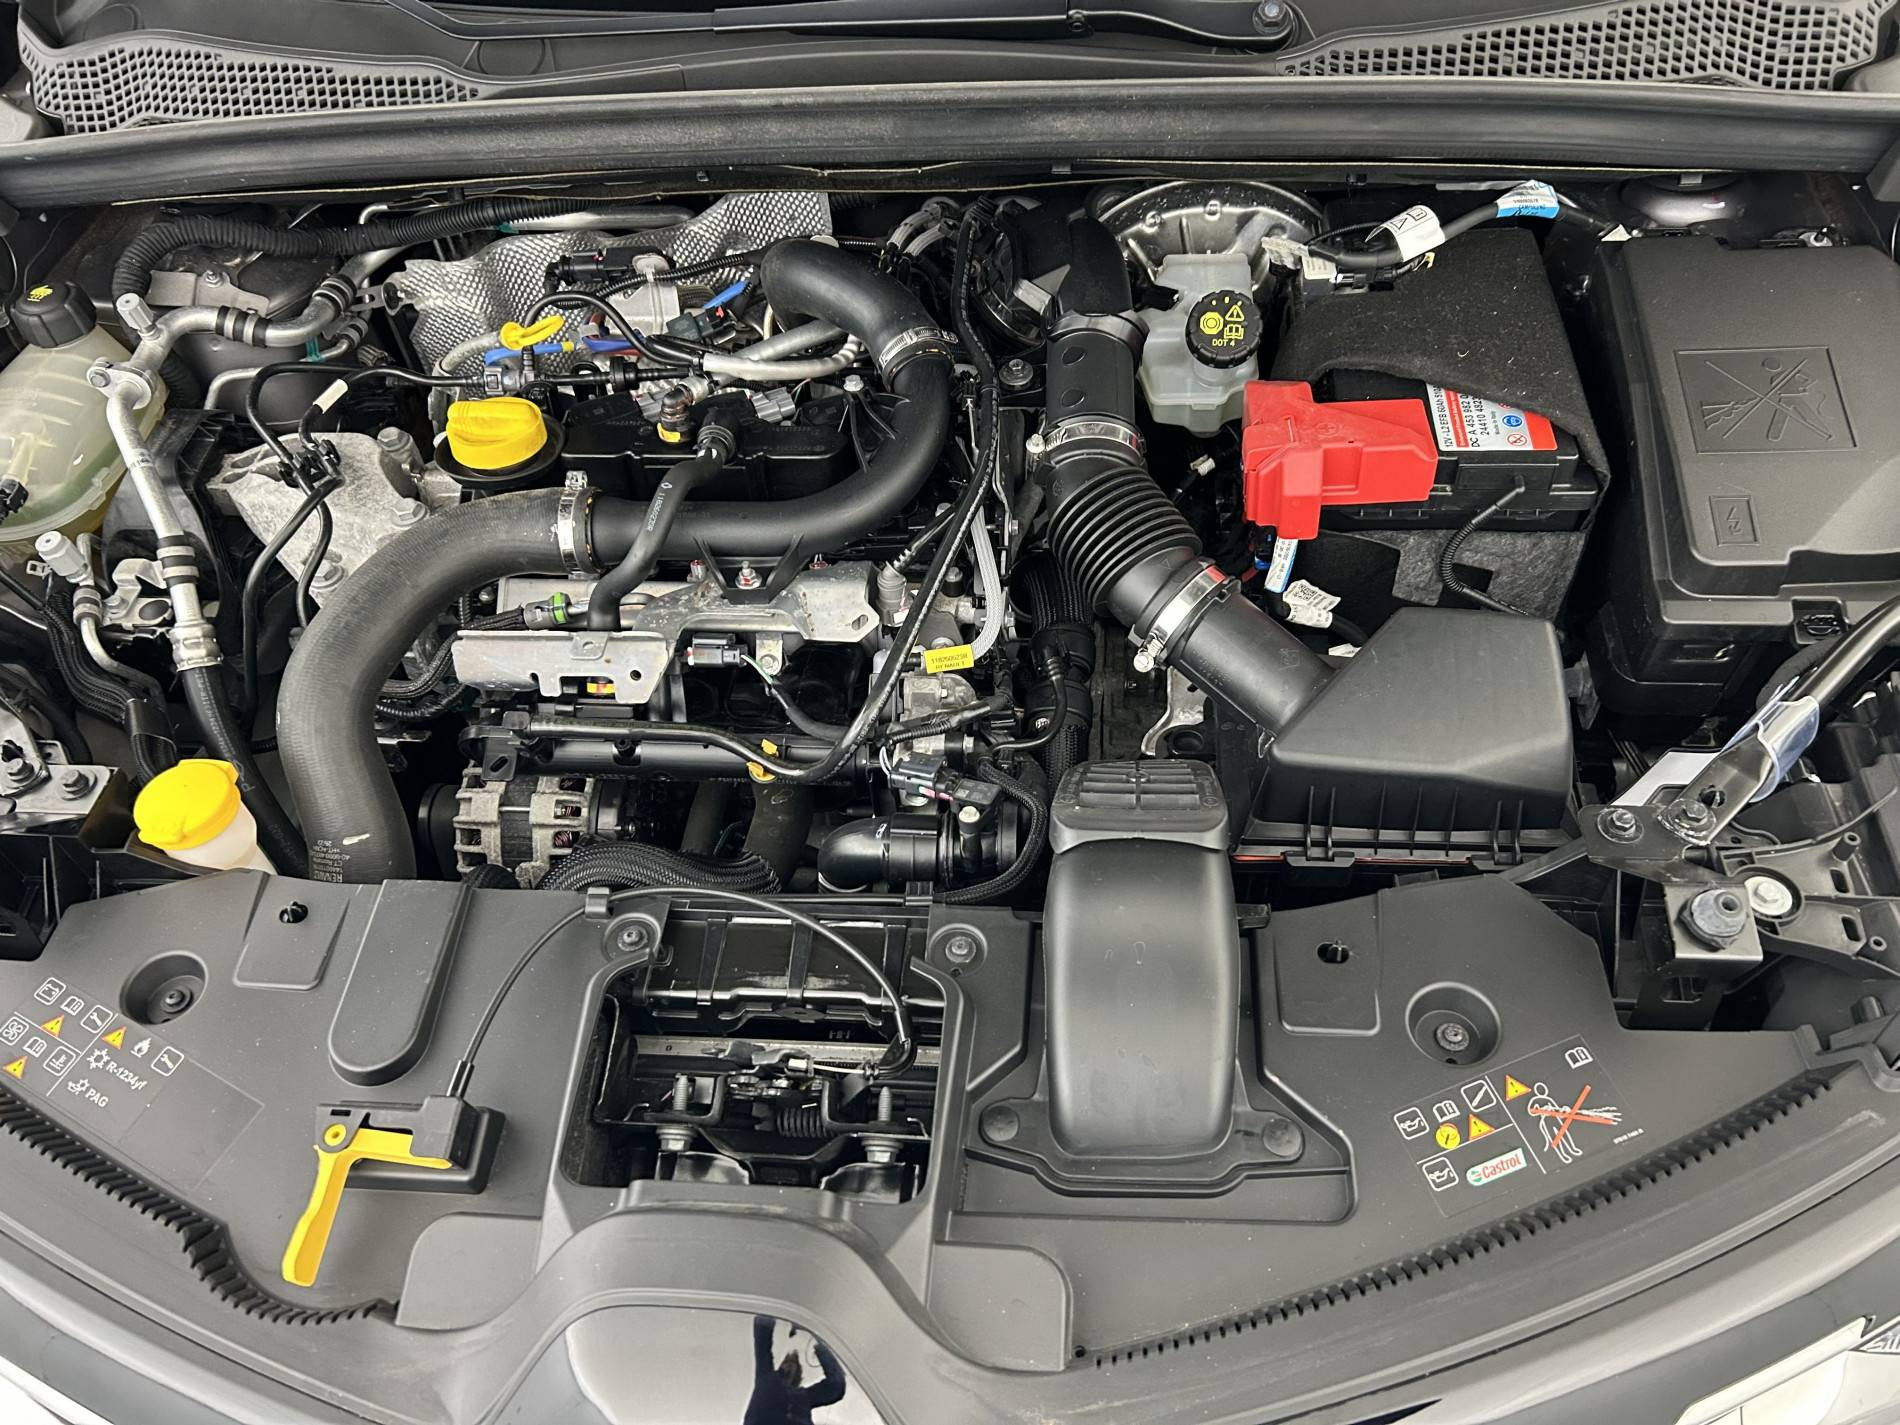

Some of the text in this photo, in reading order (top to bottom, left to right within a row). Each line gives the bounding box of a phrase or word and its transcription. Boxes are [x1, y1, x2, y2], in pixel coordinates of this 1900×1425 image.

[1212, 339, 1228, 347] DOT
[1439, 413, 1448, 425] EFB
[1465, 414, 1475, 427] 453
[1477, 414, 1490, 435] 24410
[1444, 437, 1453, 447] 12V
[105, 1060, 147, 1090] R-1234yf
[85, 1088, 109, 1108] PAG
[1481, 1153, 1522, 1179] Castrol
